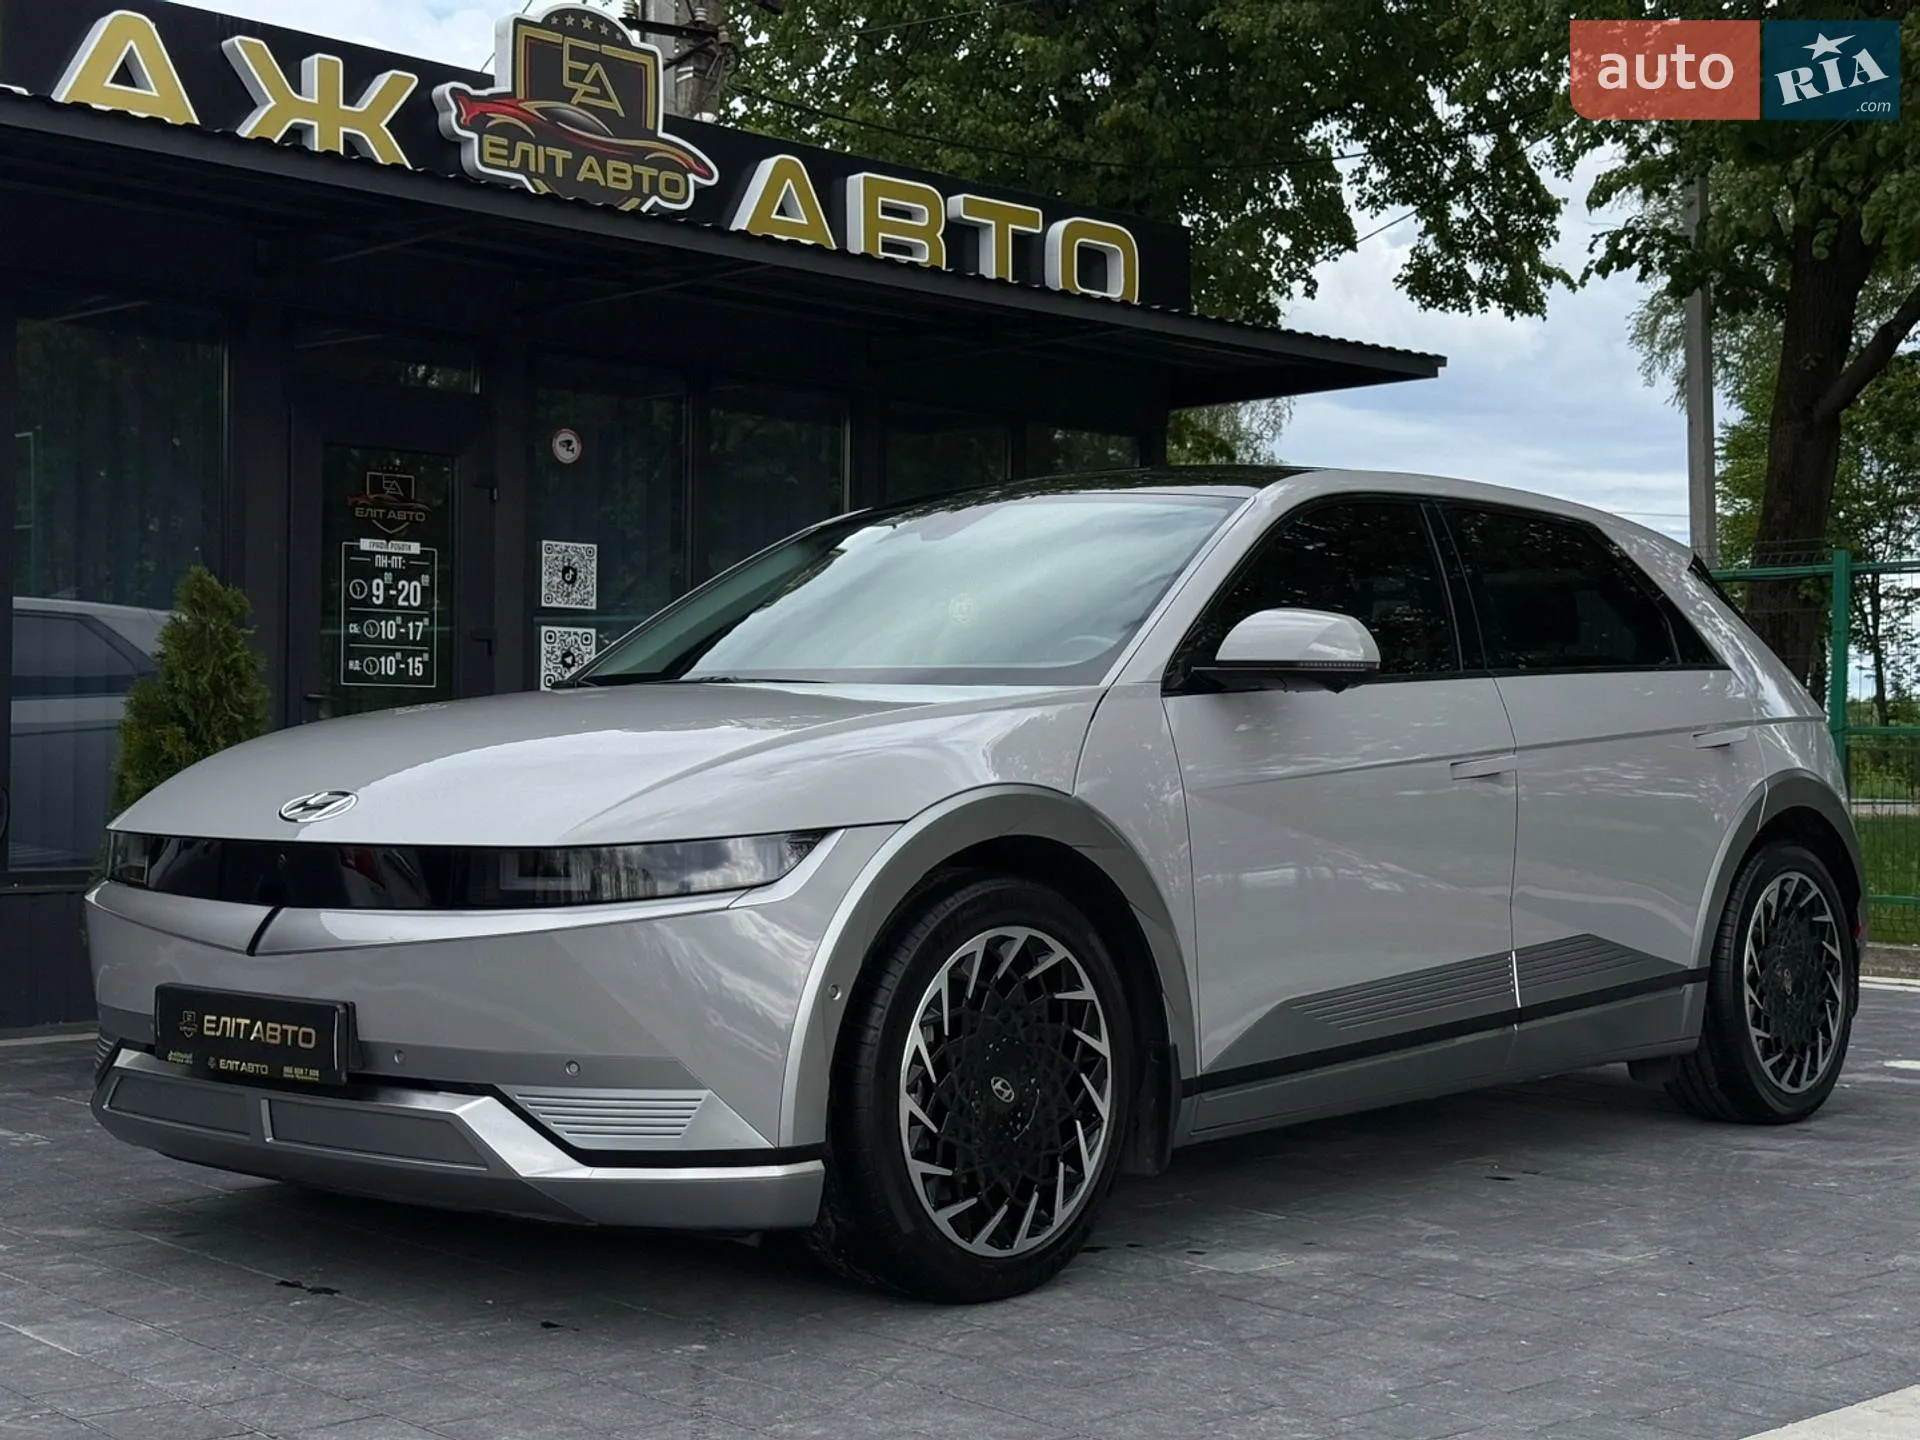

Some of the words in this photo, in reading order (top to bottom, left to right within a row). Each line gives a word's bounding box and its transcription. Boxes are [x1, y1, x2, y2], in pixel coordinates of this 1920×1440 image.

[482, 134, 572, 177] ЕЛІТ
[577, 155, 686, 201] АВТО
[730, 153, 1139, 304] АВТО
[386, 509, 426, 522] АВТО
